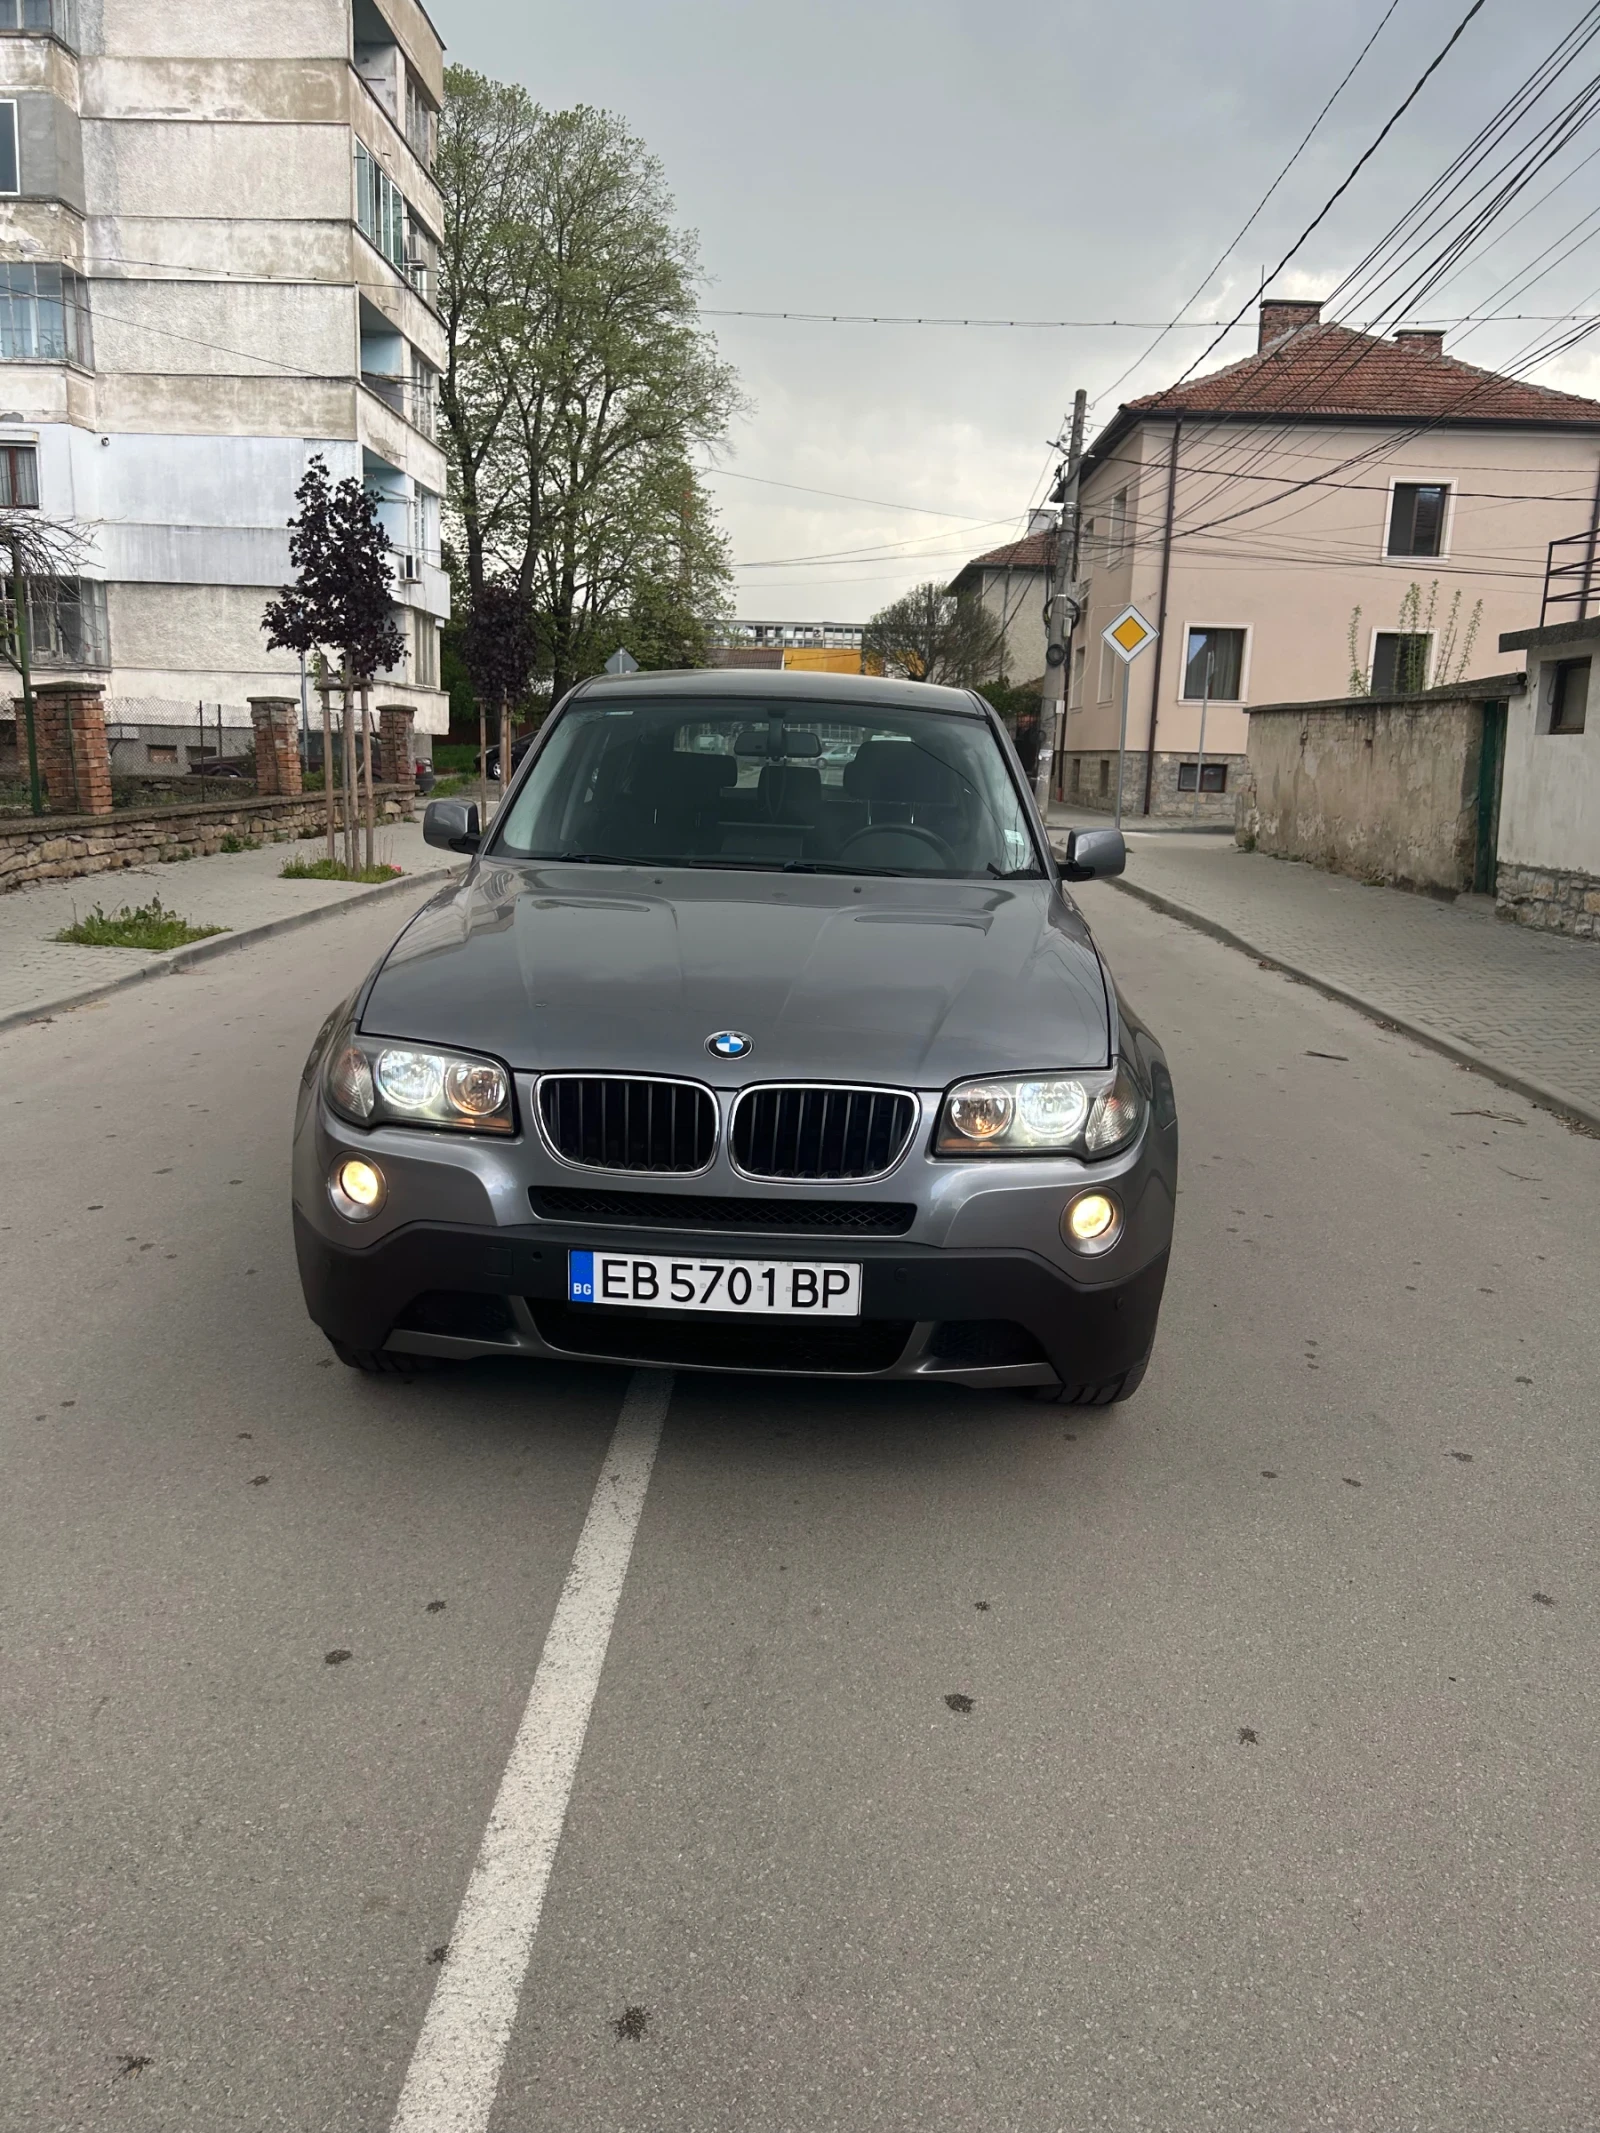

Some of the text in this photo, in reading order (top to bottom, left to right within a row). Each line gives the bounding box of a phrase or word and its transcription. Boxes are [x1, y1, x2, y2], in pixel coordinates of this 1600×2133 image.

[573, 1282, 592, 1296] BG
[602, 1259, 850, 1309] EB 5701 BP
